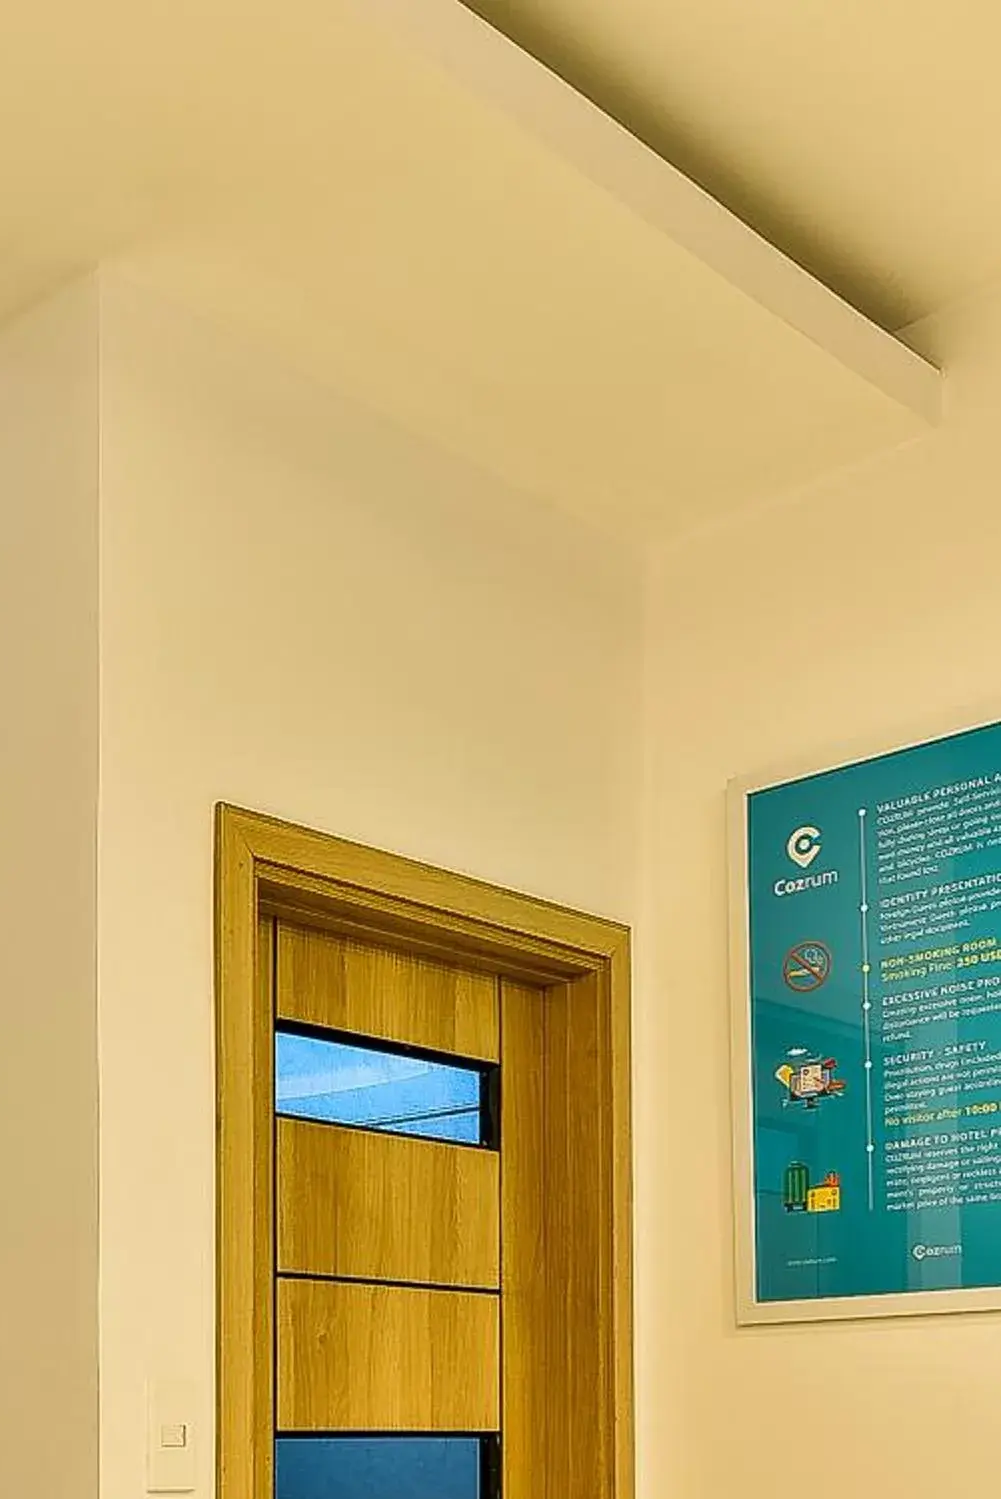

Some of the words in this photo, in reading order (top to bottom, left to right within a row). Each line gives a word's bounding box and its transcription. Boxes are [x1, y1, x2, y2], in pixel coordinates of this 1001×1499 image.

[876, 792, 931, 813] VALUABLE
[932, 776, 991, 798] PERSONAL
[774, 871, 838, 896] Cozrum
[881, 944, 960, 969] NON-SMOKING
[962, 936, 996, 953] ROOM
[881, 965, 928, 982] Smoking
[882, 986, 939, 1007] EXCESSIVE
[941, 980, 976, 996] NOISE
[949, 1009, 960, 1019] be
[883, 1048, 934, 1066] SECURITY
[944, 1040, 987, 1056] SAFETY
[884, 1116, 901, 1129] No
[902, 1112, 936, 1125] visitor
[937, 1107, 962, 1120] after
[964, 1102, 999, 1117] 10:00
[885, 1134, 933, 1151] DAMAGE
[934, 1132, 949, 1144] TO
[951, 1128, 989, 1143] HOTEL
